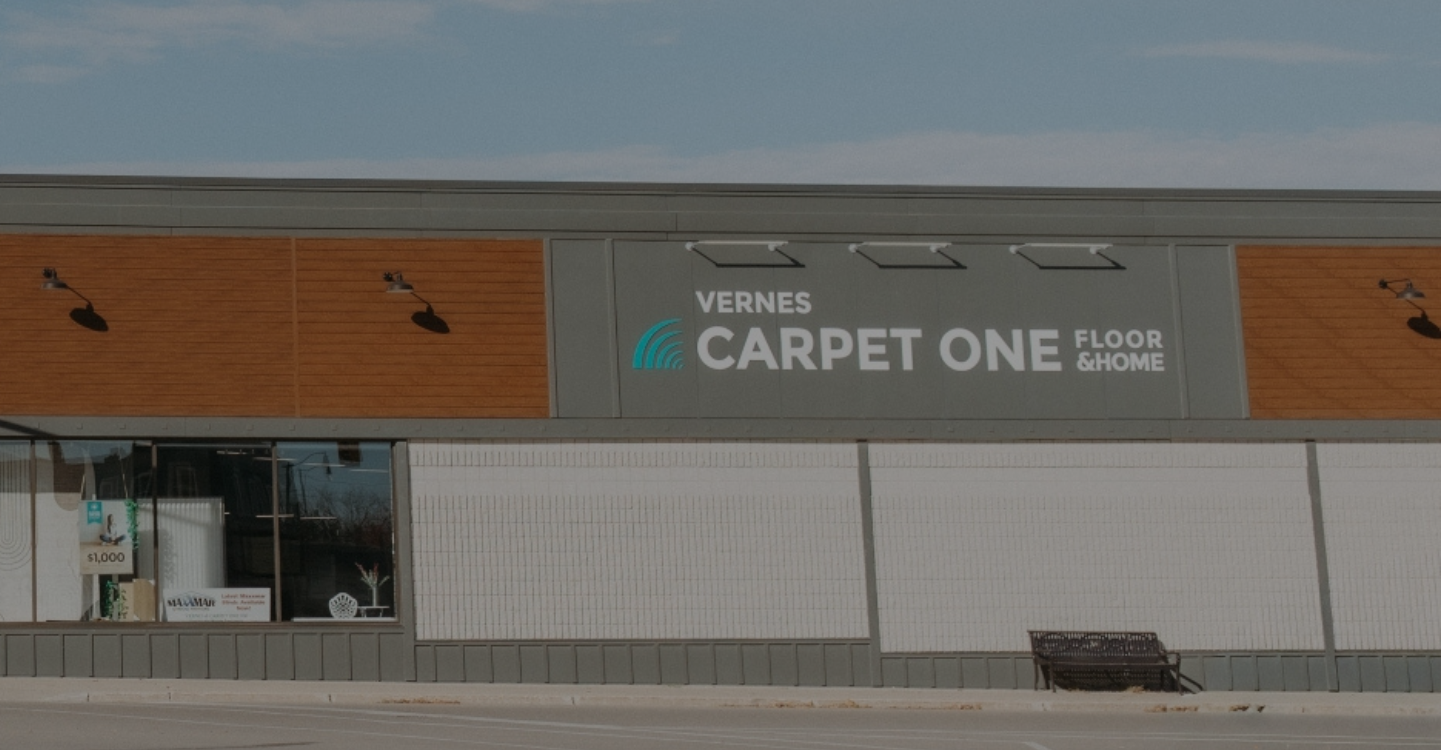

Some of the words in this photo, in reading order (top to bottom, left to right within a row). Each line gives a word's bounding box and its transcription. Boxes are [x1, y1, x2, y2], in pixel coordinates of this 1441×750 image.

[695, 290, 812, 314] VERNES
[696, 325, 923, 371] CARPET
[939, 326, 1063, 373] ONE
[1074, 329, 1164, 350] FLOOR
[1076, 352, 1165, 373] &HOME
[87, 552, 126, 564] $1,000
